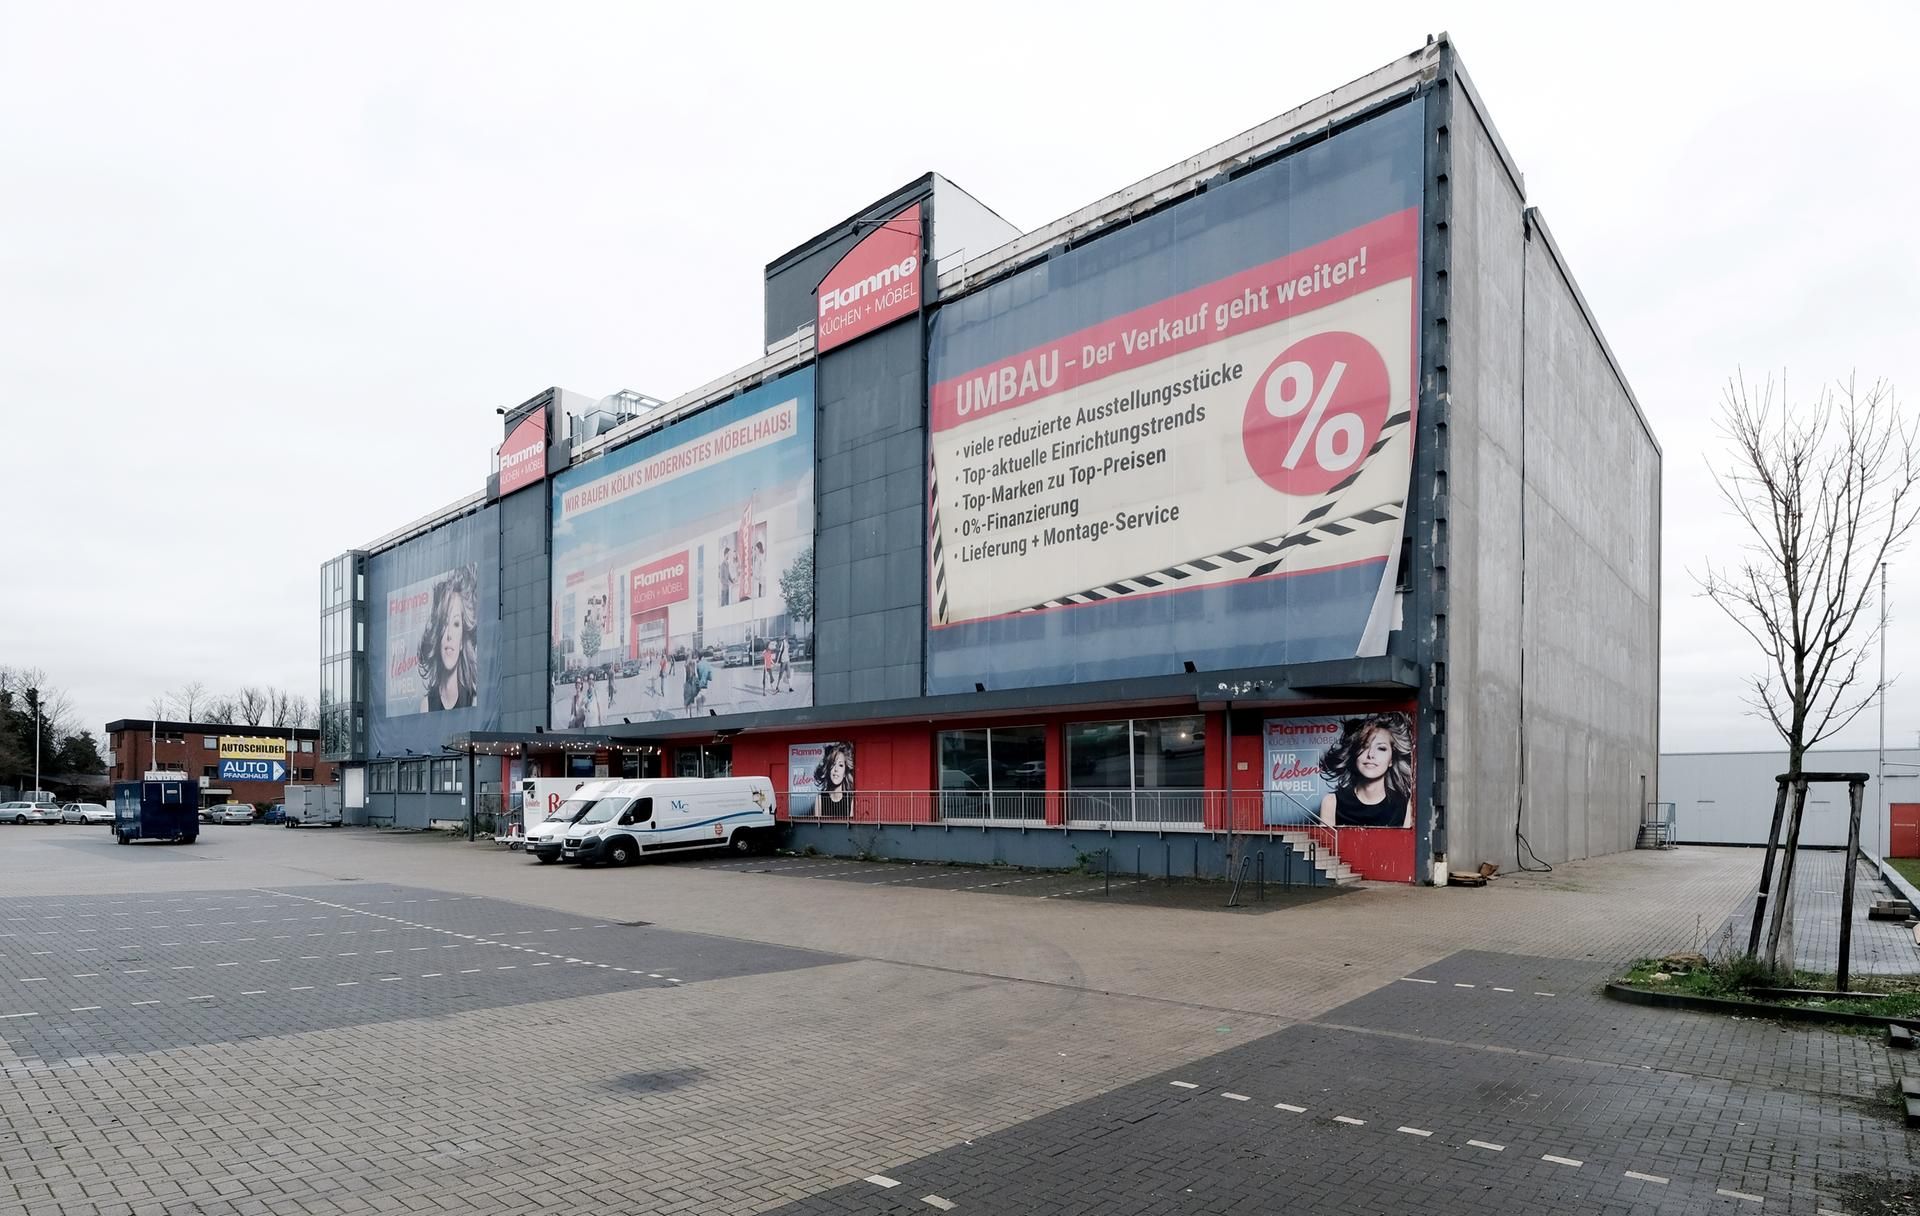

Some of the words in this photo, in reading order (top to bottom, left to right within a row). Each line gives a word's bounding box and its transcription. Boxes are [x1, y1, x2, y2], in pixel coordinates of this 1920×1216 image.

[819, 256, 918, 317] Flamme
[819, 307, 862, 337] KÜCHEN
[874, 281, 918, 313] MÖBEL
[957, 350, 1059, 416] UMBAU
[1082, 341, 1116, 369] Der
[1121, 302, 1208, 355] Verkauf
[1215, 286, 1269, 331] geht
[1277, 246, 1367, 304] weiter!
[963, 436, 994, 458] viele
[998, 415, 1071, 448] reduzierte
[1076, 362, 1243, 426] Ausstellungsstücke
[1264, 360, 1365, 472] %
[500, 440, 544, 471] Flamme
[565, 495, 580, 513] WIR
[581, 483, 609, 506] BAUEN
[611, 470, 642, 494] KÖLN'S
[644, 441, 711, 482] MODERNSTES
[714, 410, 791, 457] MÖBELHAUS!
[962, 448, 1047, 485] Top-aktuelle
[1052, 403, 1206, 461] Einrichtungstrends
[962, 479, 1043, 511] Top-Marken
[1047, 473, 1065, 490] zu
[1069, 447, 1166, 485] Top-Preisen
[961, 538, 1027, 562] Lieferung
[1031, 535, 1040, 548] +
[1043, 504, 1180, 546] Montage-Service
[962, 498, 1079, 537] 0%-Finanzierung
[633, 563, 684, 590] Flamme
[389, 592, 429, 616] Flamme
[221, 743, 285, 754] AUTOSCHILDER
[1268, 723, 1338, 736] Flamme
[223, 761, 268, 773] AUTO
[791, 748, 823, 756] Flamme
[1272, 753, 1297, 765] WIR
[1272, 759, 1321, 781] lieben
